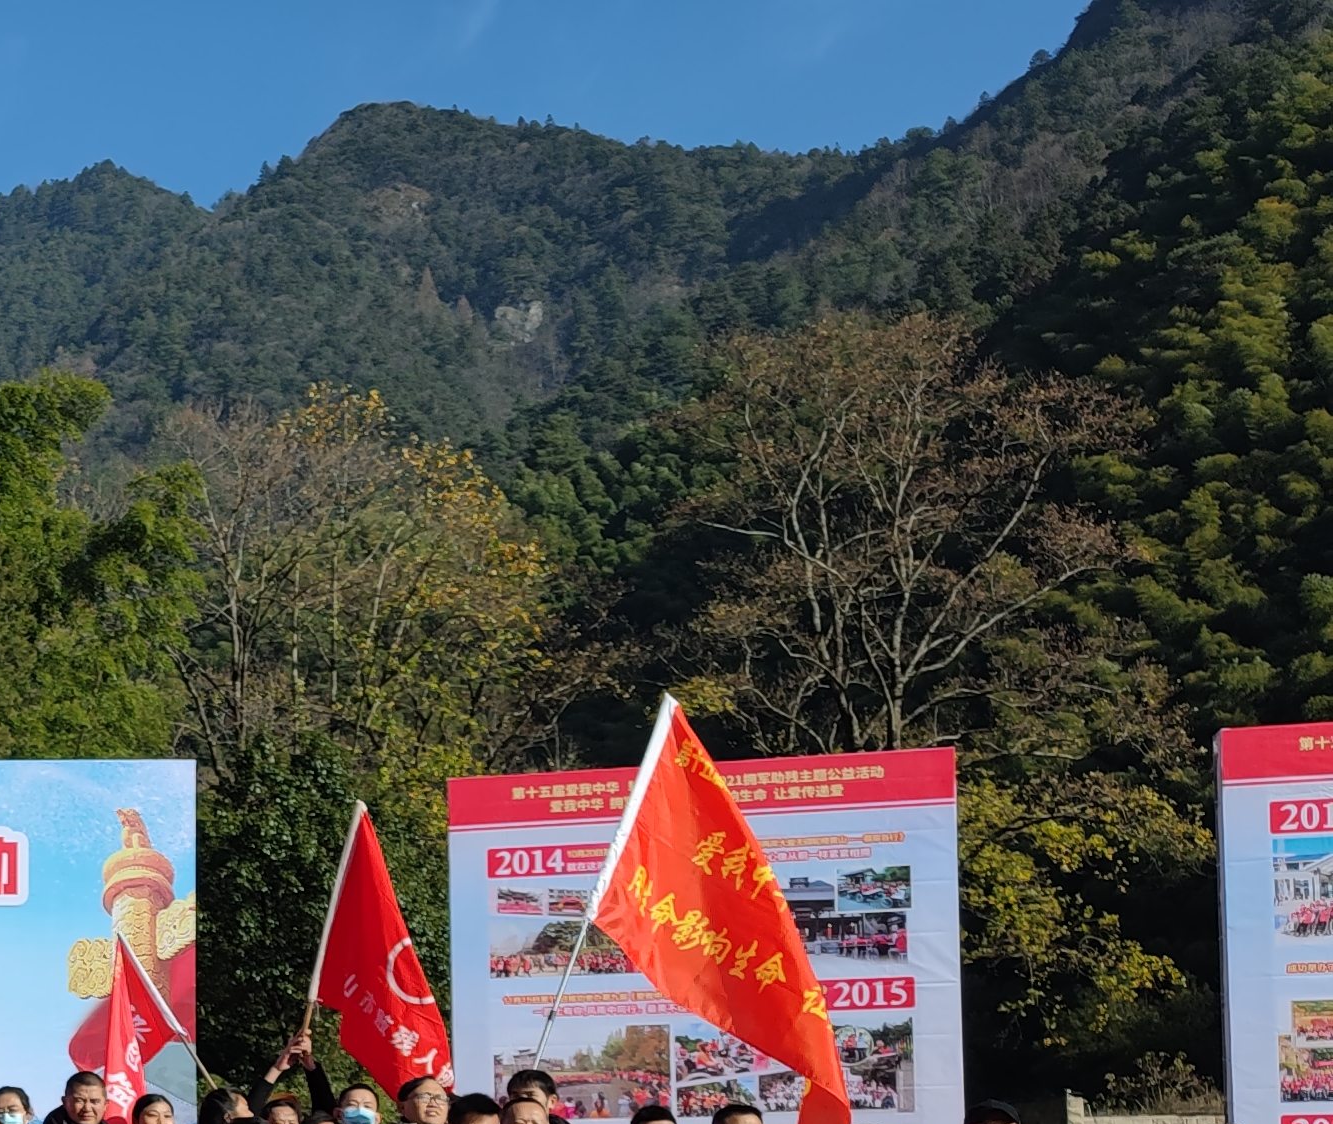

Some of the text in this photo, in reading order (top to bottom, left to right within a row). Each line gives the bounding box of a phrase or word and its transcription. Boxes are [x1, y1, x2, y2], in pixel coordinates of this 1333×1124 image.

[1299, 735, 1333, 752] 第十
[511, 781, 620, 800] 第十五届爱我中华
[549, 797, 604, 813] 爱我中华
[773, 784, 844, 801] 让爱传递爱
[494, 848, 564, 876] 2014
[831, 980, 908, 1008] 2015
